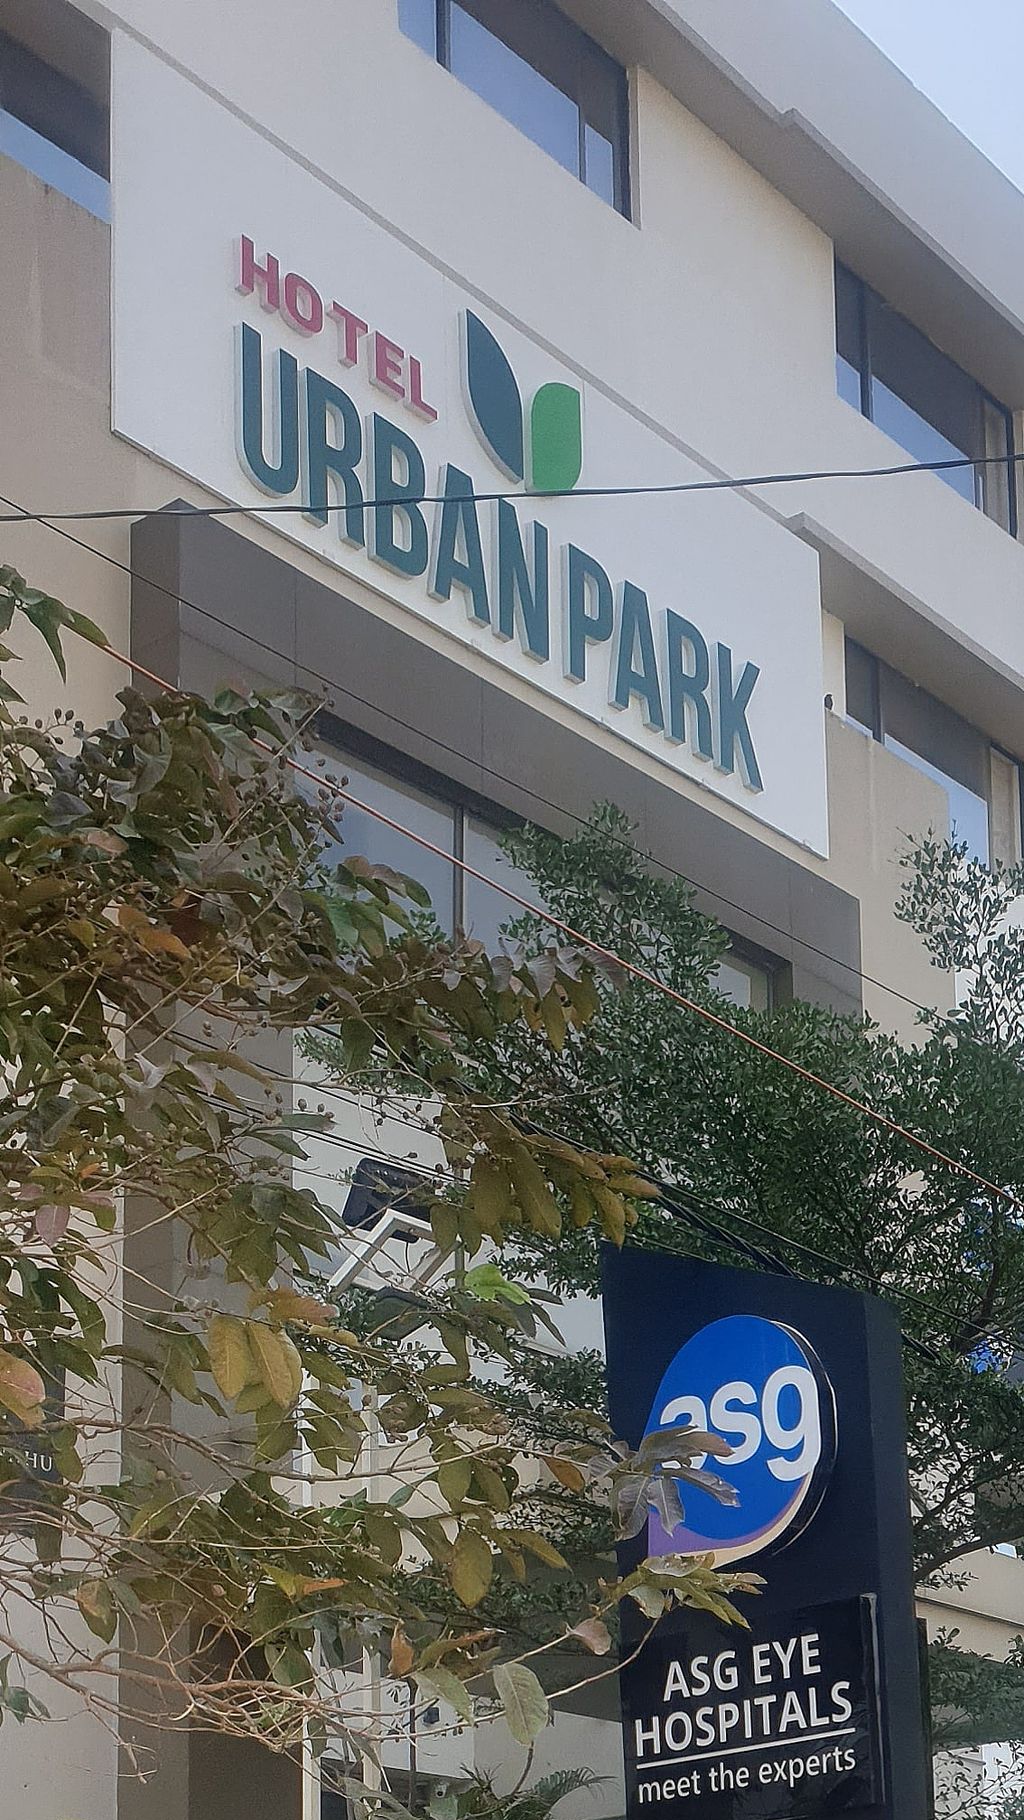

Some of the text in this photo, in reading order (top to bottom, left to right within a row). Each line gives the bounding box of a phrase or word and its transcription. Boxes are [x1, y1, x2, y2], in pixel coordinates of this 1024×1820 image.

[235, 233, 438, 422] HOTEL
[234, 321, 763, 794] URBAN PARK
[660, 1365, 821, 1482] asg
[663, 1633, 822, 1702] ASG EYE
[634, 1680, 852, 1757] HOSPITALS
[638, 1746, 856, 1804] meet the experts
